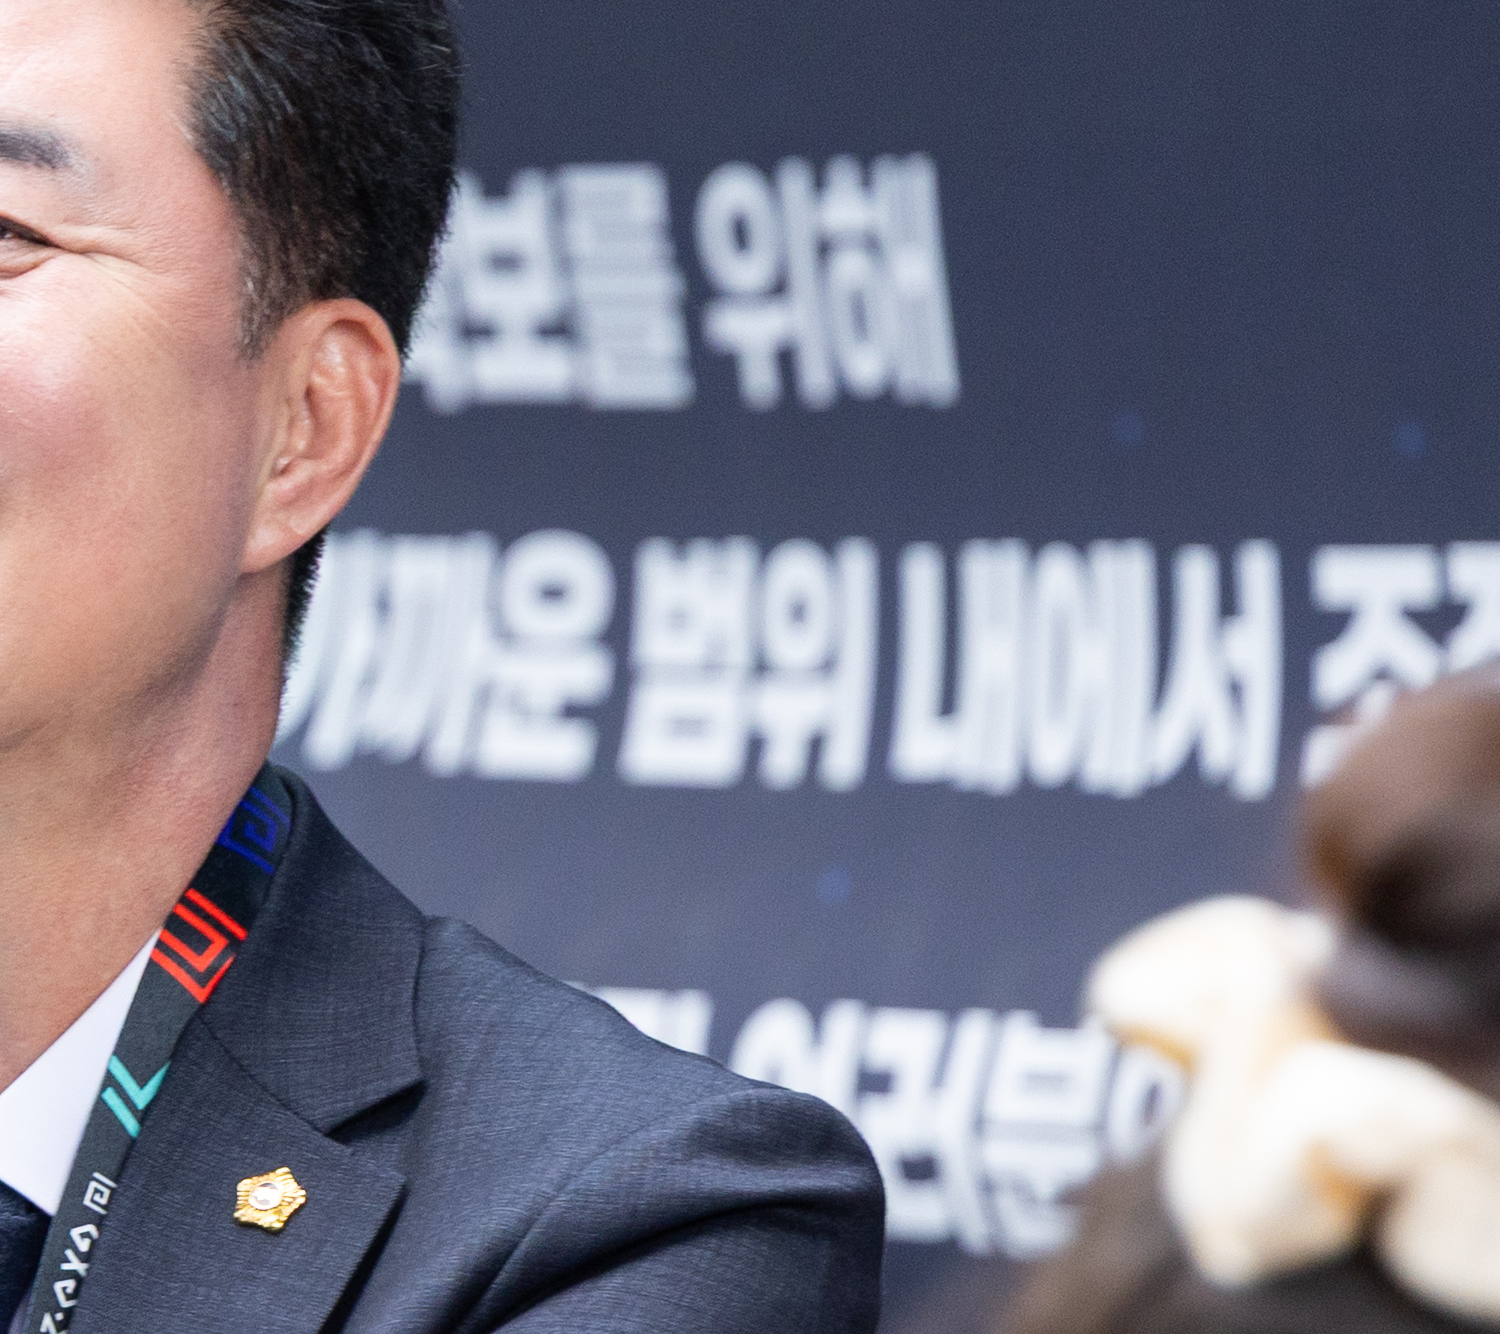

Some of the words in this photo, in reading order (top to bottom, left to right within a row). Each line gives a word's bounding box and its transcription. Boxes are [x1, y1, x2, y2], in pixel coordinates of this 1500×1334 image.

[402, 162, 697, 413] 보를
[693, 151, 961, 409] 위해
[618, 534, 878, 791] 범위
[889, 537, 1282, 801] 내에서
